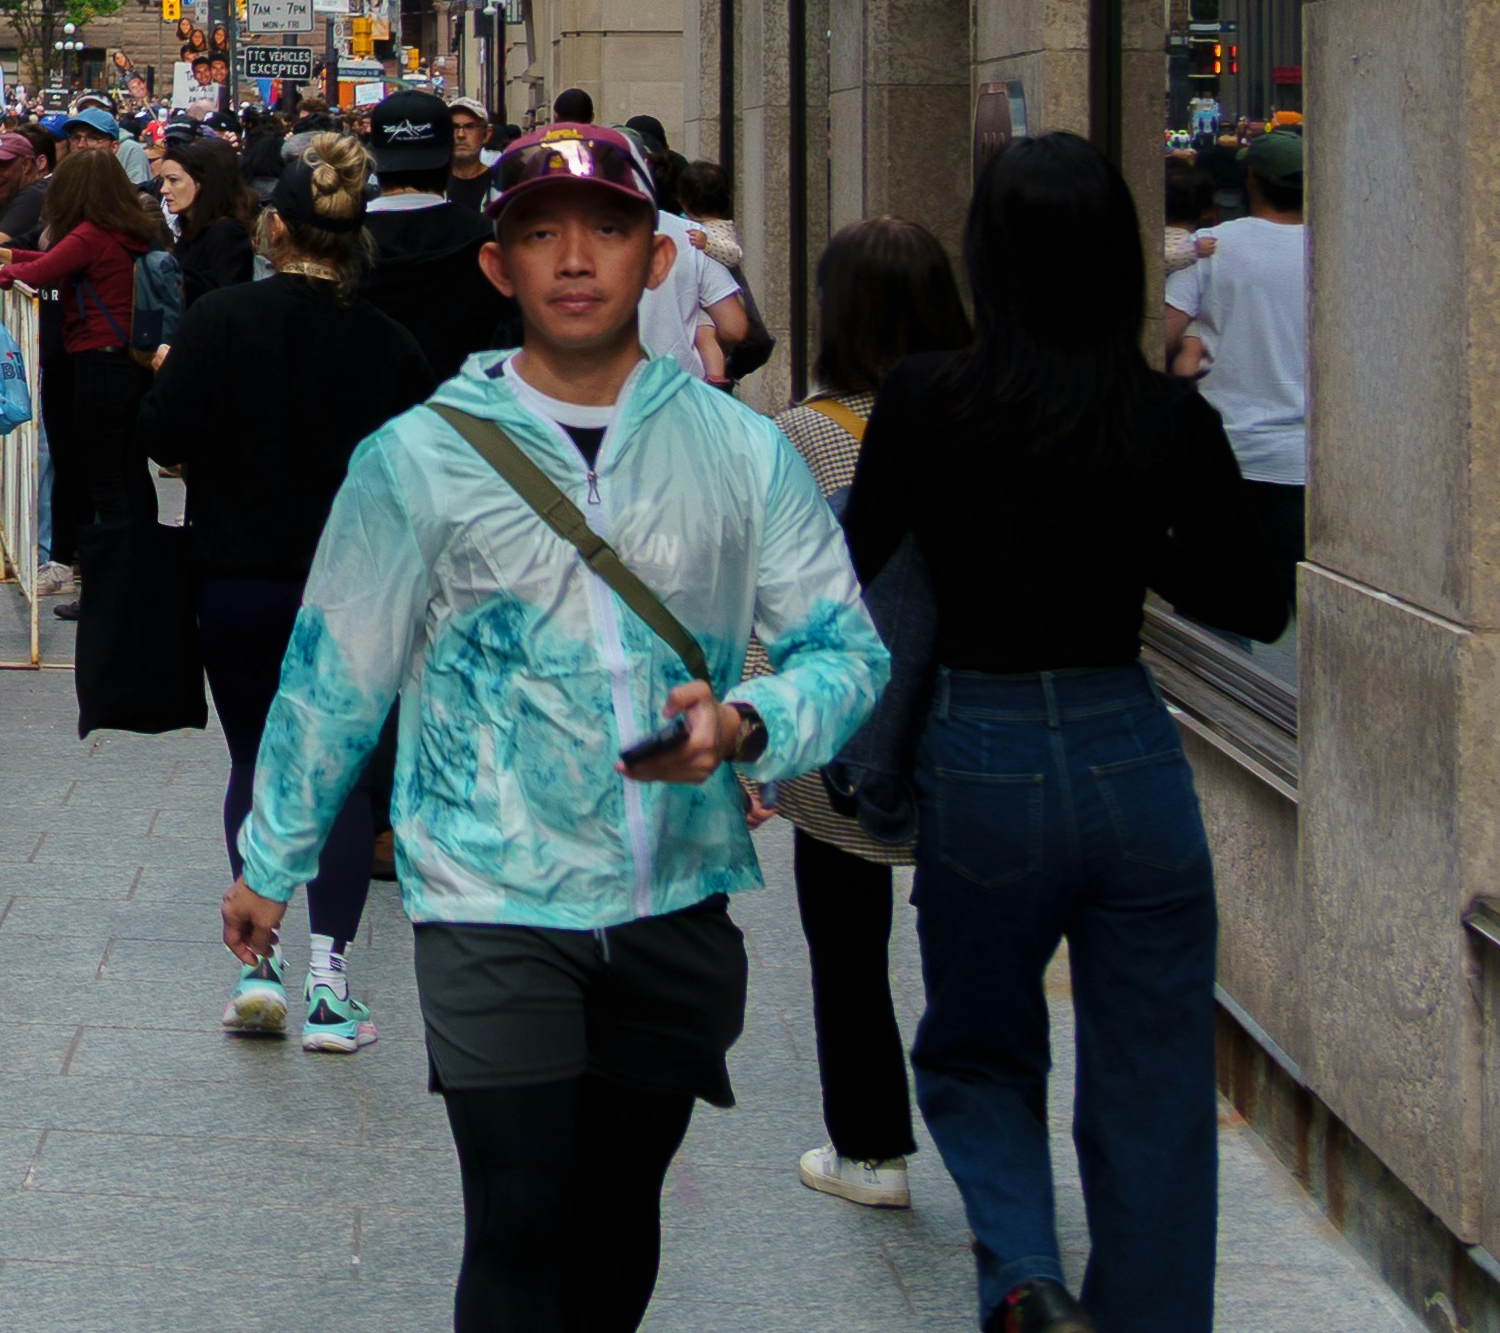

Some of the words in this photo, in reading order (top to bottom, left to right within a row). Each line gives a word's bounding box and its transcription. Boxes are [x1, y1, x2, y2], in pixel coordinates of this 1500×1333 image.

[248, 51, 265, 61] TTC
[269, 51, 310, 63] VEHICLES
[250, 63, 307, 75] EXCEPTED
